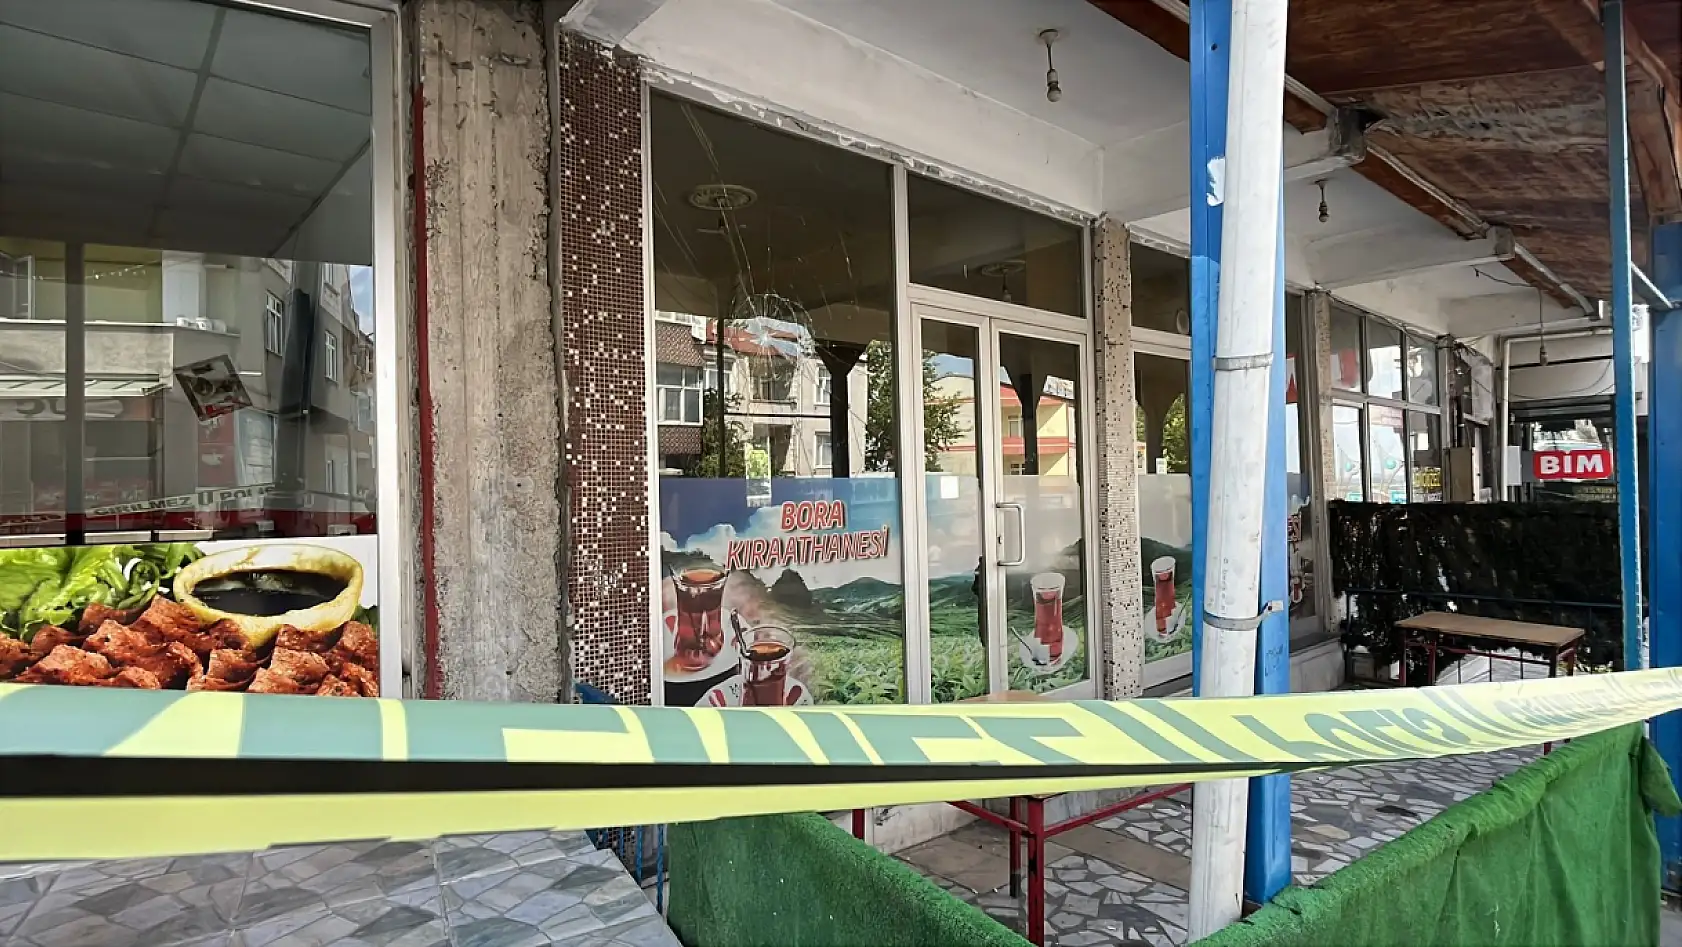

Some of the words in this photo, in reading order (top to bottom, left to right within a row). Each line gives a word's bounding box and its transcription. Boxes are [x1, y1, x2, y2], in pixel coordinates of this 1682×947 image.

[1540, 450, 1604, 474] BİM
[780, 500, 846, 530] BORA
[725, 525, 889, 570] KIRAATHANESİ
